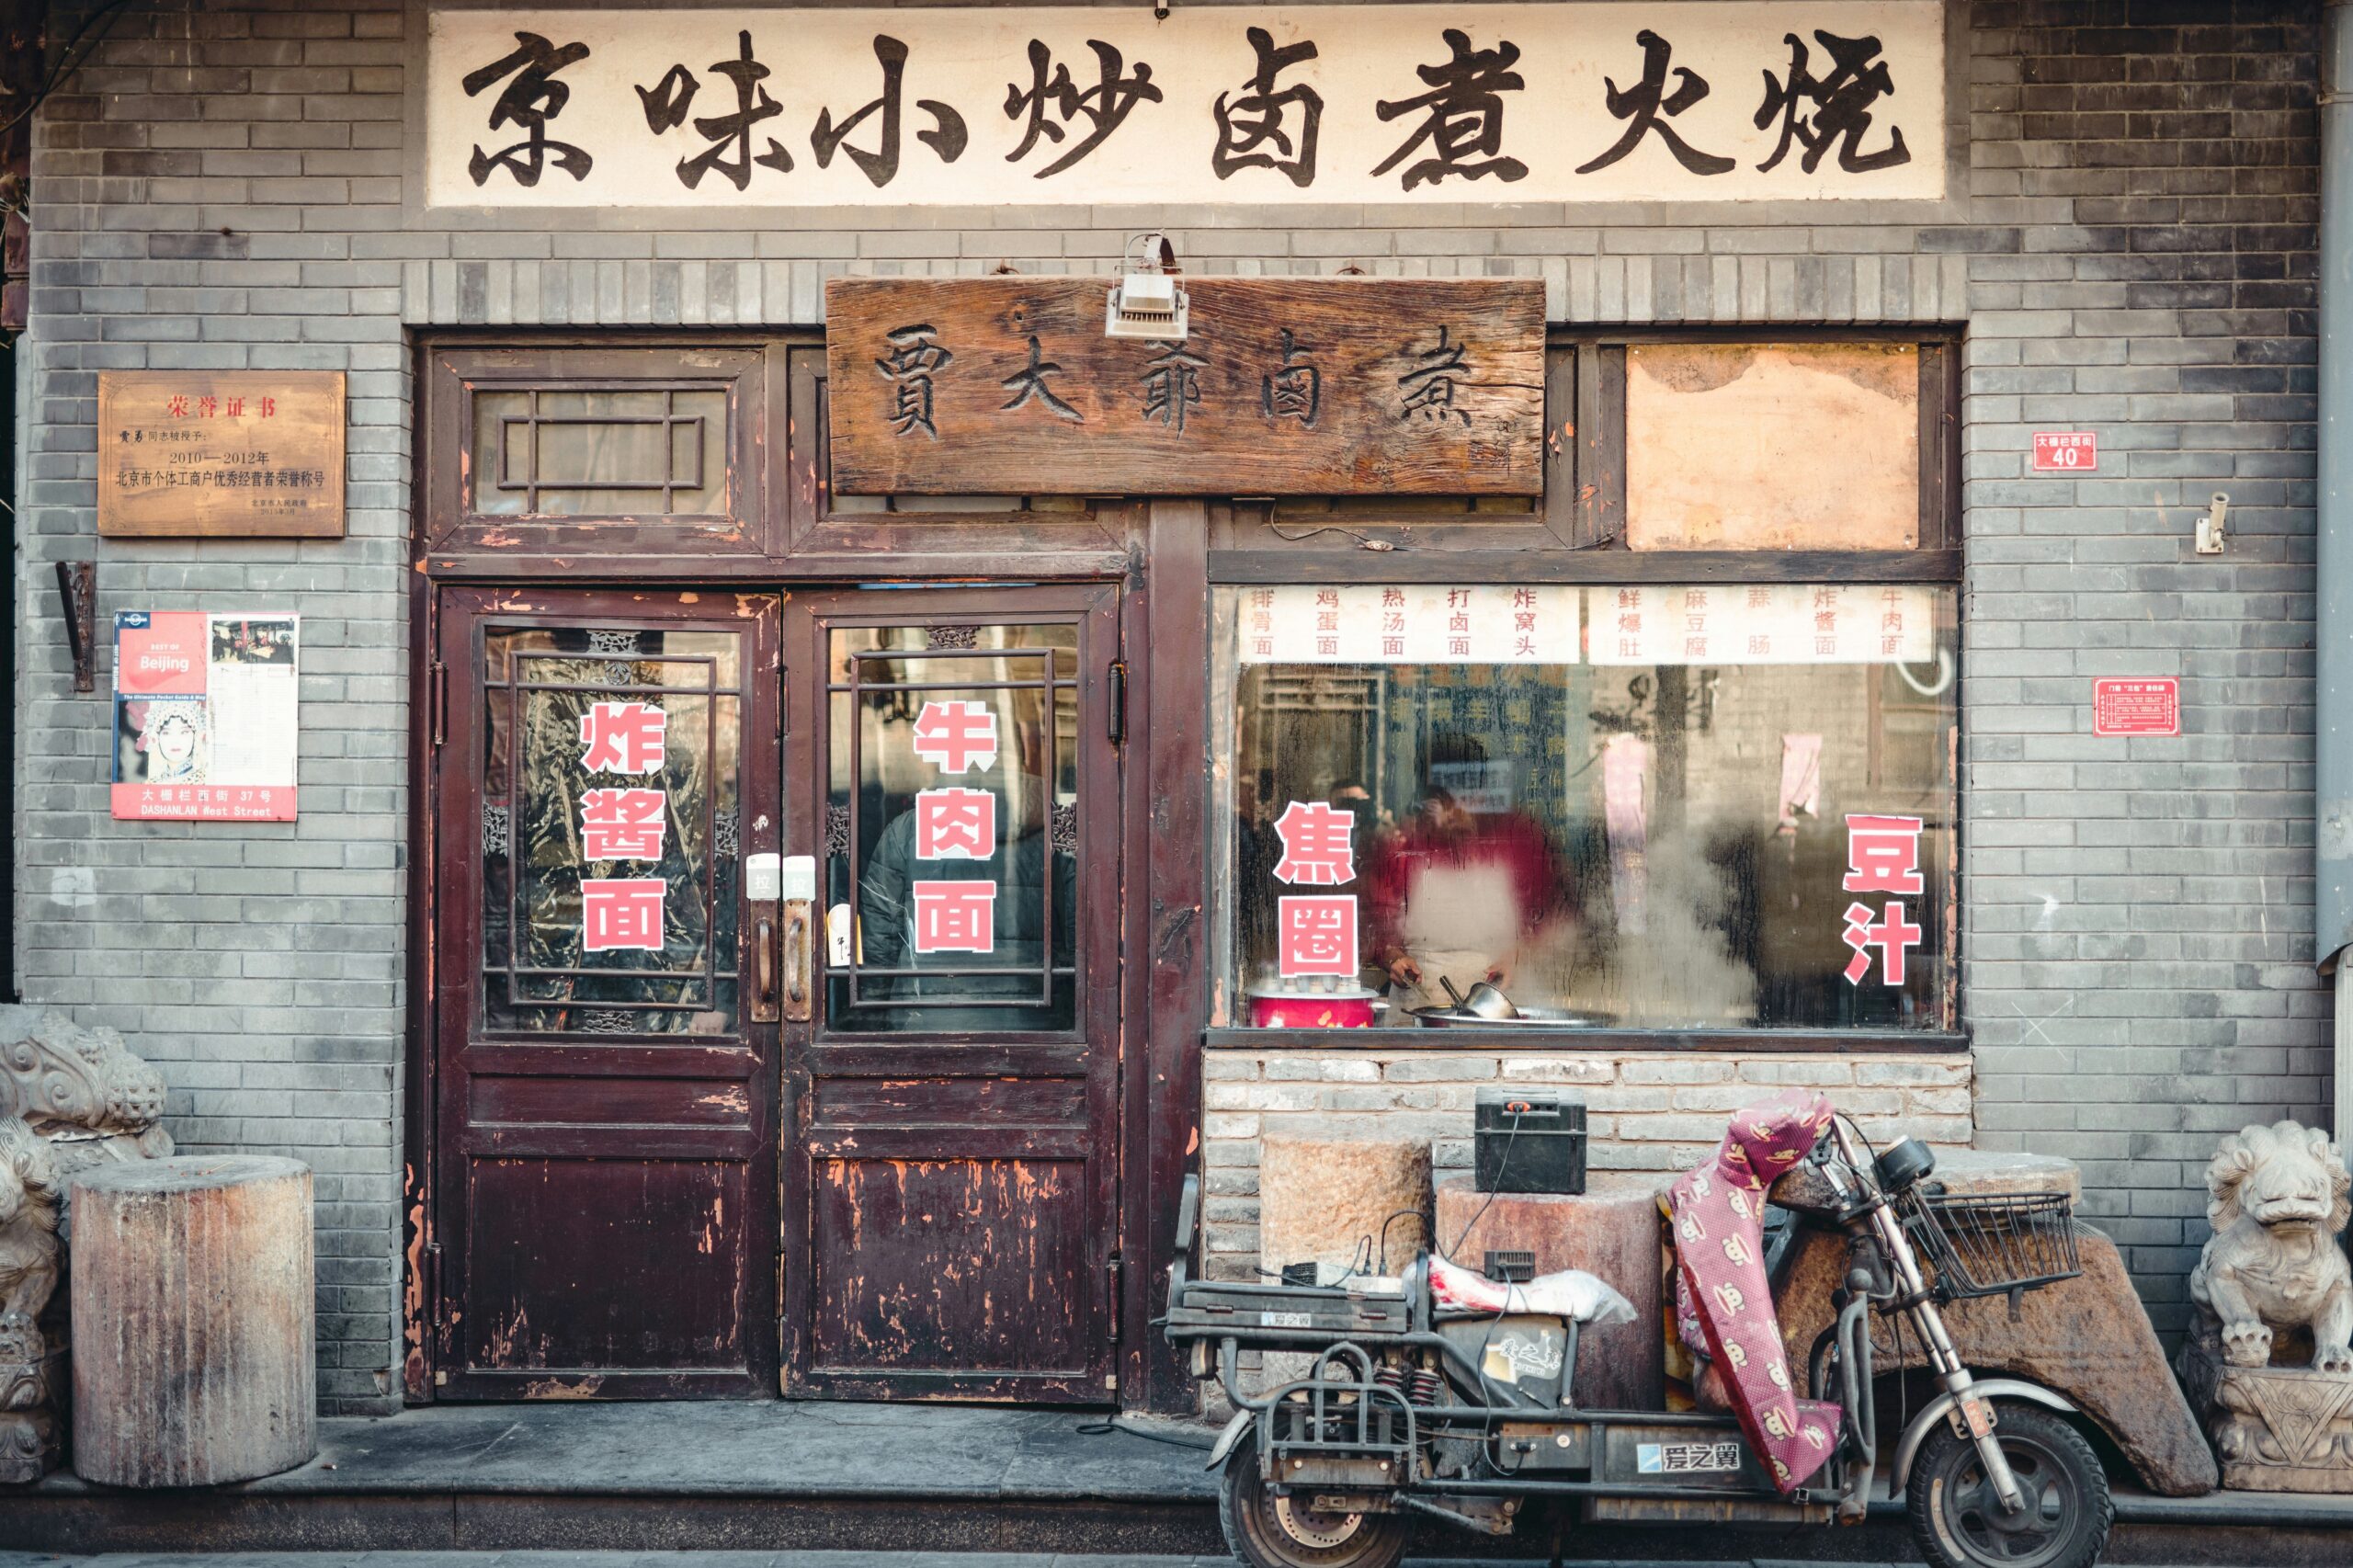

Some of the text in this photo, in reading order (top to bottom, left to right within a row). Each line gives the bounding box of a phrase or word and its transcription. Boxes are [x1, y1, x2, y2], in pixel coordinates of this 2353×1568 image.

[167, 395, 276, 418] 荣誉证书
[116, 471, 324, 487] 北京市个体工商户优秀经营者荣誉称号
[2052, 448, 2077, 466] 40
[1251, 589, 1274, 655] 排骨面
[1316, 588, 1339, 655] 鸡蛋面
[1382, 588, 1405, 655] 热汤面
[1448, 588, 1472, 655] 打卤面
[1513, 588, 1537, 655] 炸窝头
[1618, 589, 1642, 657] 鲜爆肚
[1684, 589, 1707, 656] 麻豆腐
[1813, 588, 1837, 655] 炸酱面
[1881, 588, 1904, 655] 牛肉面
[141, 655, 189, 672] Beijing
[141, 806, 271, 816] DASHANLAN West Street
[142, 790, 228, 801] 大栅栏西街
[579, 701, 668, 951] 炸酱面
[913, 699, 997, 952] 牛肉面
[755, 874, 770, 890] 拉
[1274, 801, 1358, 978] 焦圈
[1843, 814, 1924, 986] 豆汁
[1663, 1444, 1740, 1472] 爱之翼
